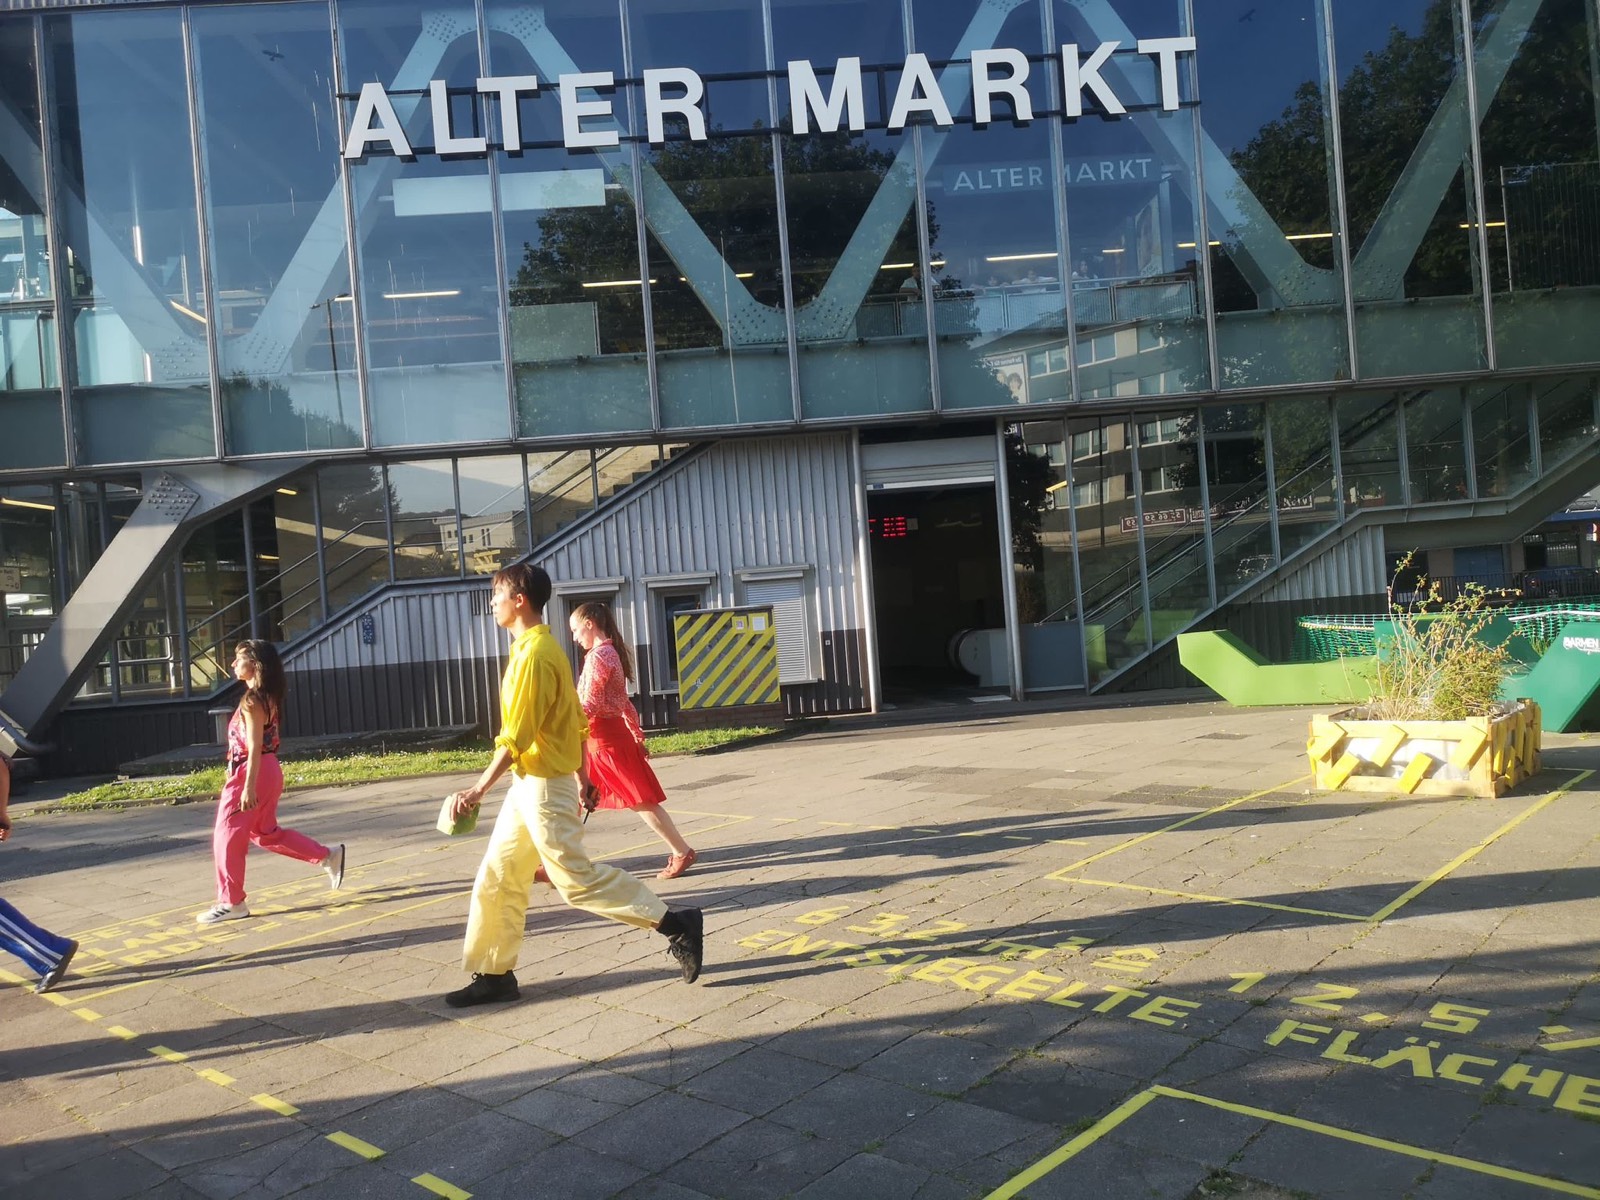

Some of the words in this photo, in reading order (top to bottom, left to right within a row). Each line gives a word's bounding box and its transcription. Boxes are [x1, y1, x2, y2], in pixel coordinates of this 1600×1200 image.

[345, 68, 708, 159] ALTER
[788, 36, 1197, 134] MARKT
[953, 166, 1043, 191] ALTER
[734, 929, 1202, 1026] ENTSIEGELTE
[1264, 1019, 1600, 1116] FLÄCHE
